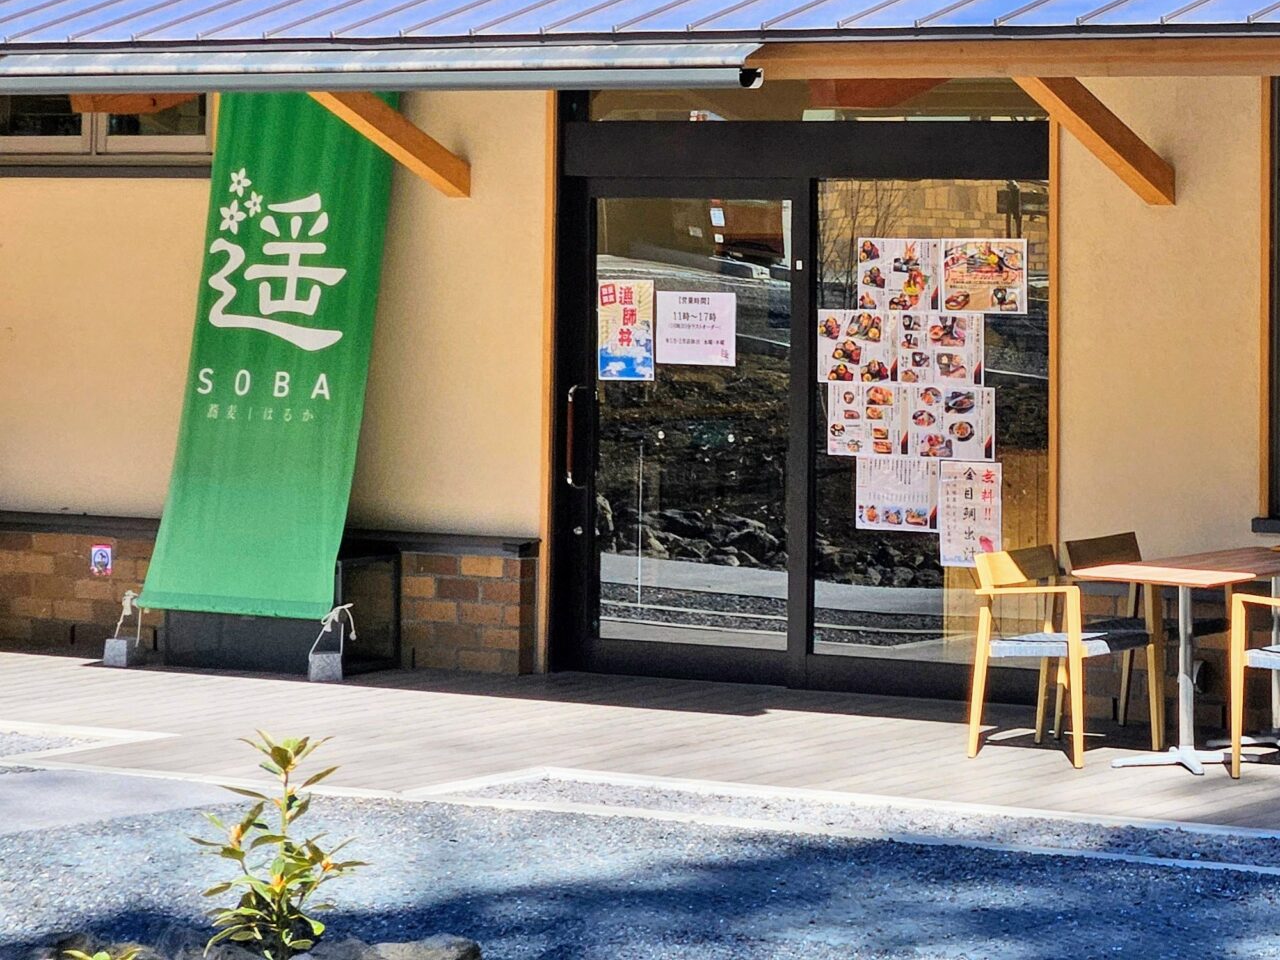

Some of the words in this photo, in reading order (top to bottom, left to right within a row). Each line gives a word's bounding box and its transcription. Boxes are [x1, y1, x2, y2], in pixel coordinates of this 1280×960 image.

[208, 192, 348, 352] 遥
[618, 286, 638, 347] 漁師丼
[197, 368, 331, 400] SOBA
